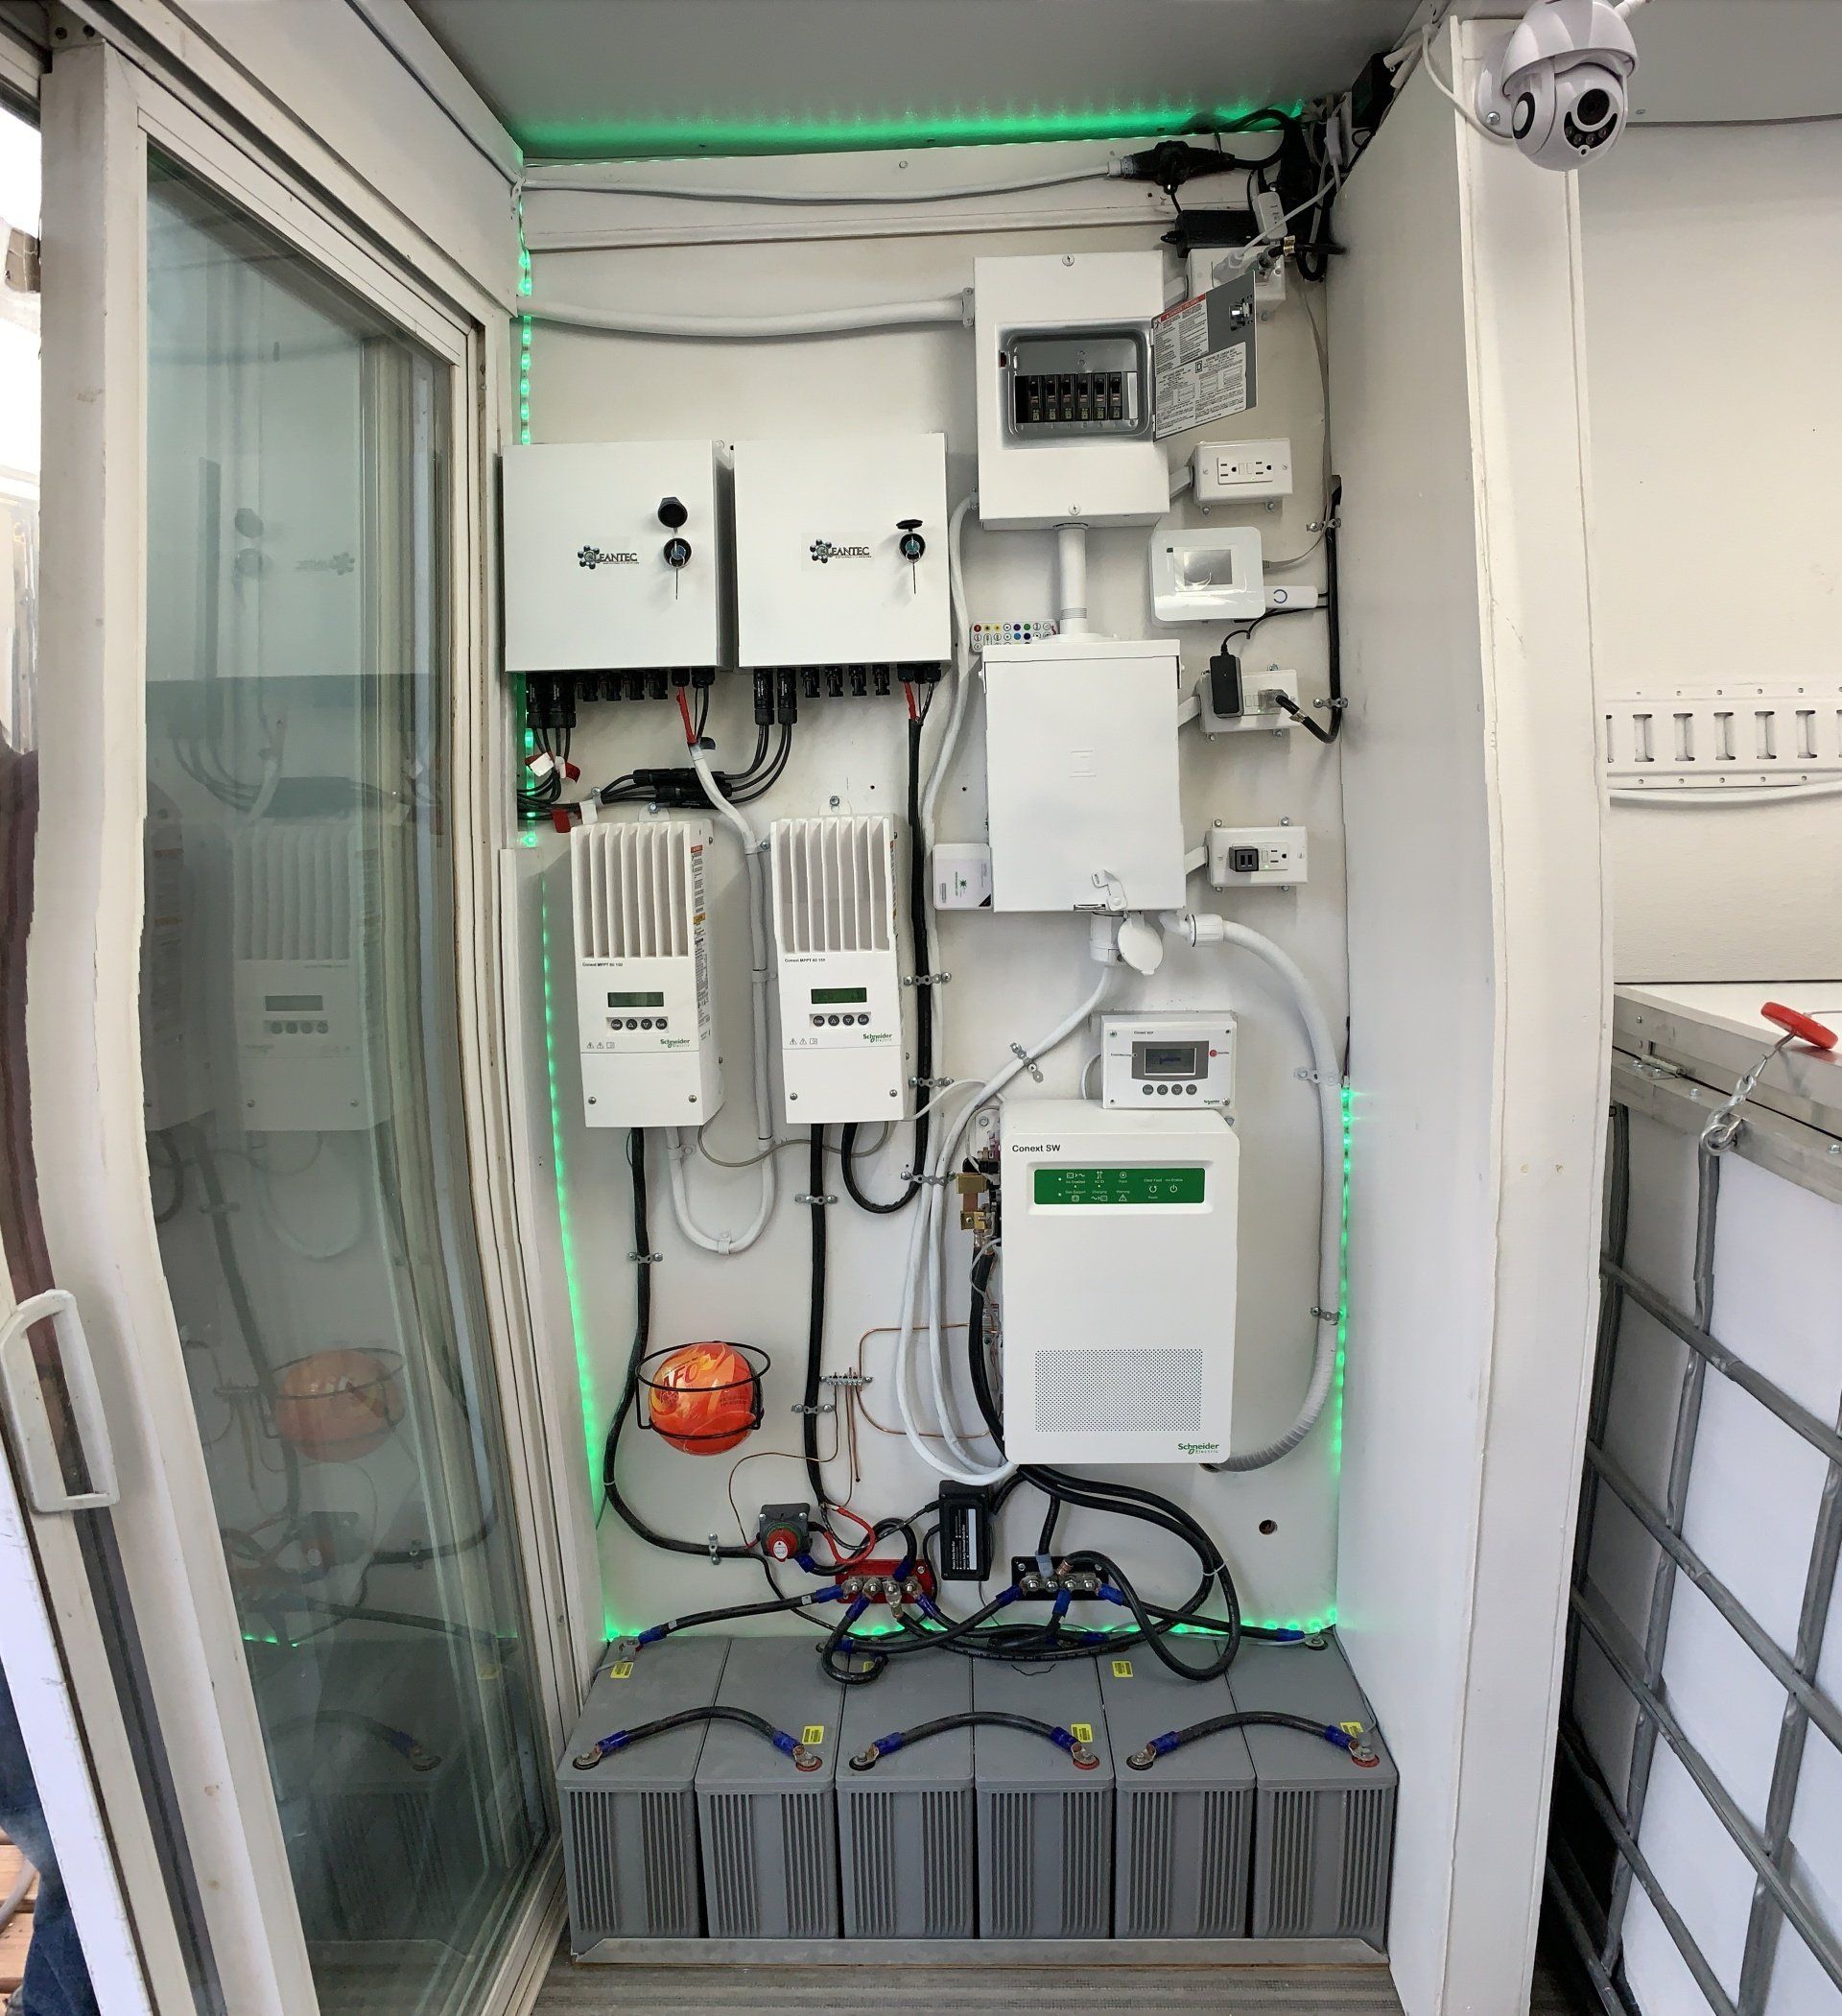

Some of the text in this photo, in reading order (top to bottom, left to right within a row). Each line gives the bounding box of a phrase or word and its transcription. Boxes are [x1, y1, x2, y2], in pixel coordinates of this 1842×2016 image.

[863, 1033, 892, 1043] Schneider
[660, 1039, 690, 1048] Schneider
[1012, 1144, 1044, 1152] Conext
[1177, 1442, 1219, 1455] Schneider
